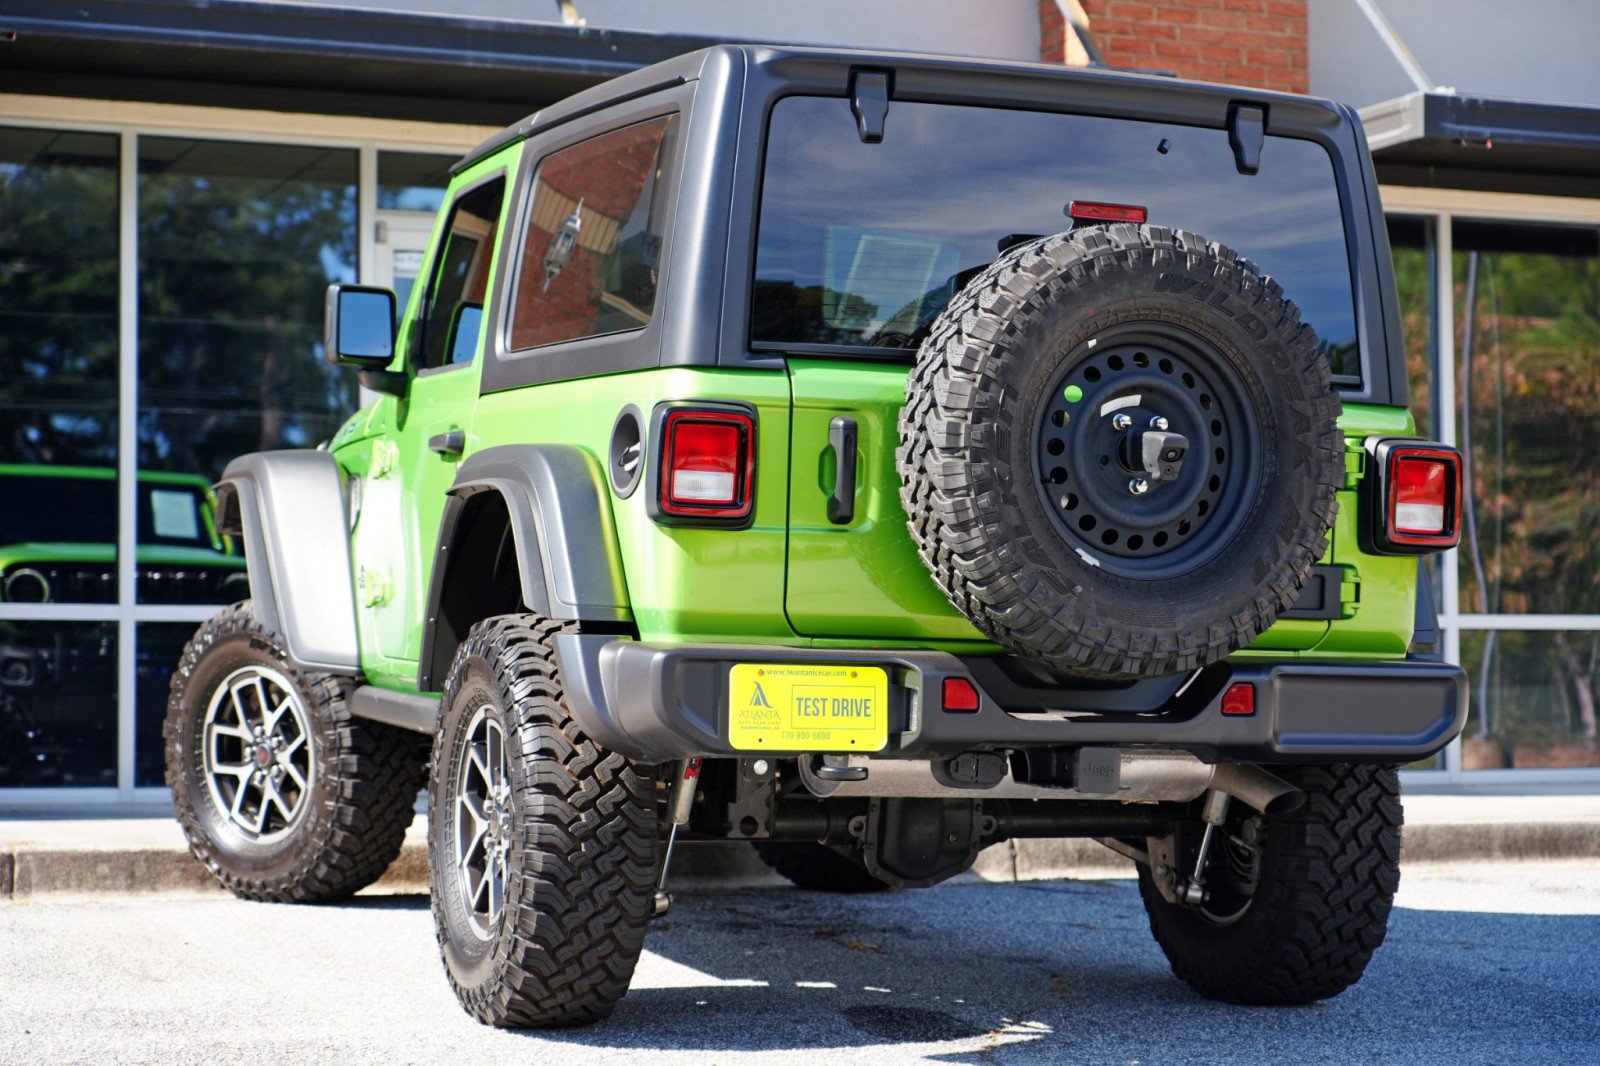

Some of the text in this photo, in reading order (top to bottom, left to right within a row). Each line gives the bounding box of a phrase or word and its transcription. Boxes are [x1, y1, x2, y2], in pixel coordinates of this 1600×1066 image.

[1153, 272, 1312, 479] WILDPEAK
[766, 668, 847, 677] www.iwantanicecar.com
[739, 710, 782, 720] ATLANTA
[796, 698, 872, 717] TEST DRIVE
[1083, 760, 1114, 777] Jeep
